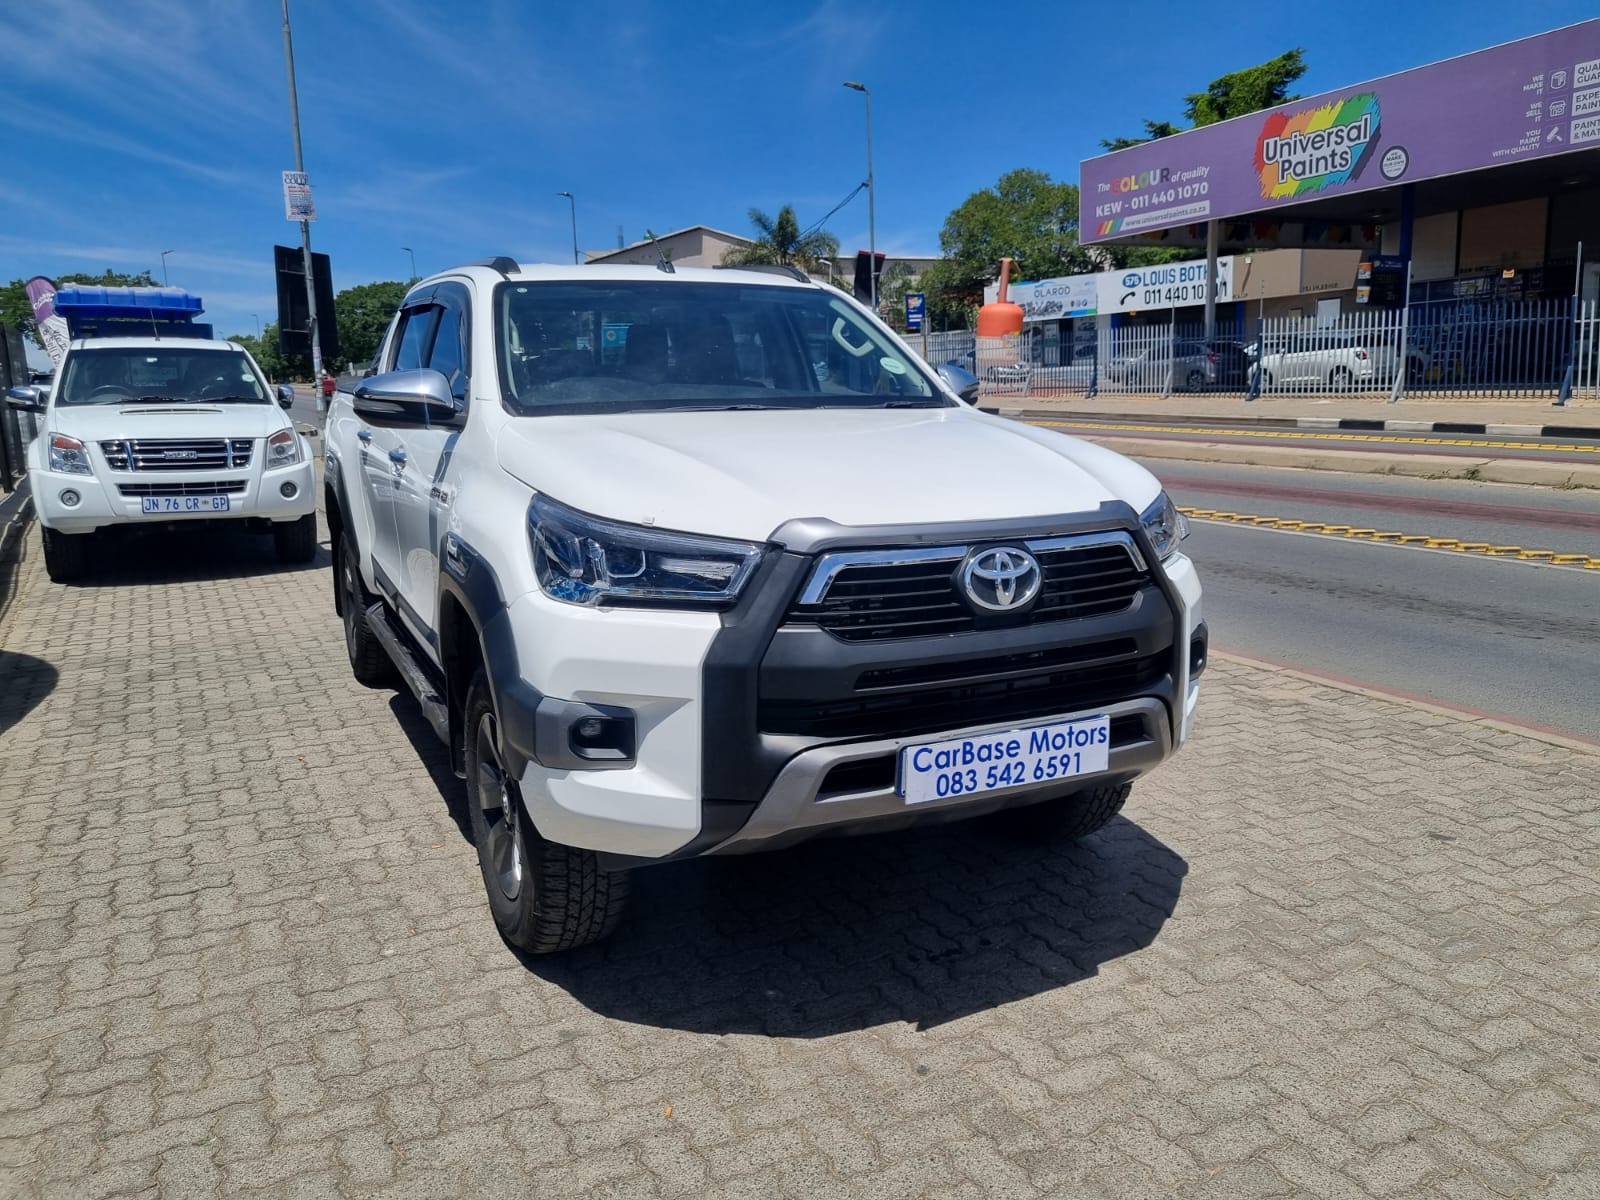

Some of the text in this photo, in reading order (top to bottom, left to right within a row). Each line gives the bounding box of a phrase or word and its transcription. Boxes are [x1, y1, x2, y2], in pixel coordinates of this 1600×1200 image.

[1577, 62, 1600, 76] QUA
[1265, 116, 1369, 162] Universal
[1526, 129, 1541, 138] YOU
[1492, 143, 1541, 157] WITH QUALITY
[1279, 149, 1350, 182] Paints
[1097, 165, 1210, 195] The COLOUR of quality
[1095, 201, 1122, 218] KEW
[1131, 194, 1149, 210] 011
[1151, 189, 1175, 205] 440
[1178, 181, 1209, 199] 1070
[1143, 268, 1176, 287] LOUIS
[1144, 289, 1161, 304] 011
[1165, 285, 1188, 302] 440
[145, 496, 226, 511] JN 76 CR GP
[913, 725, 1107, 773] CarBase Motors
[936, 752, 1081, 797] 083 542 6591
